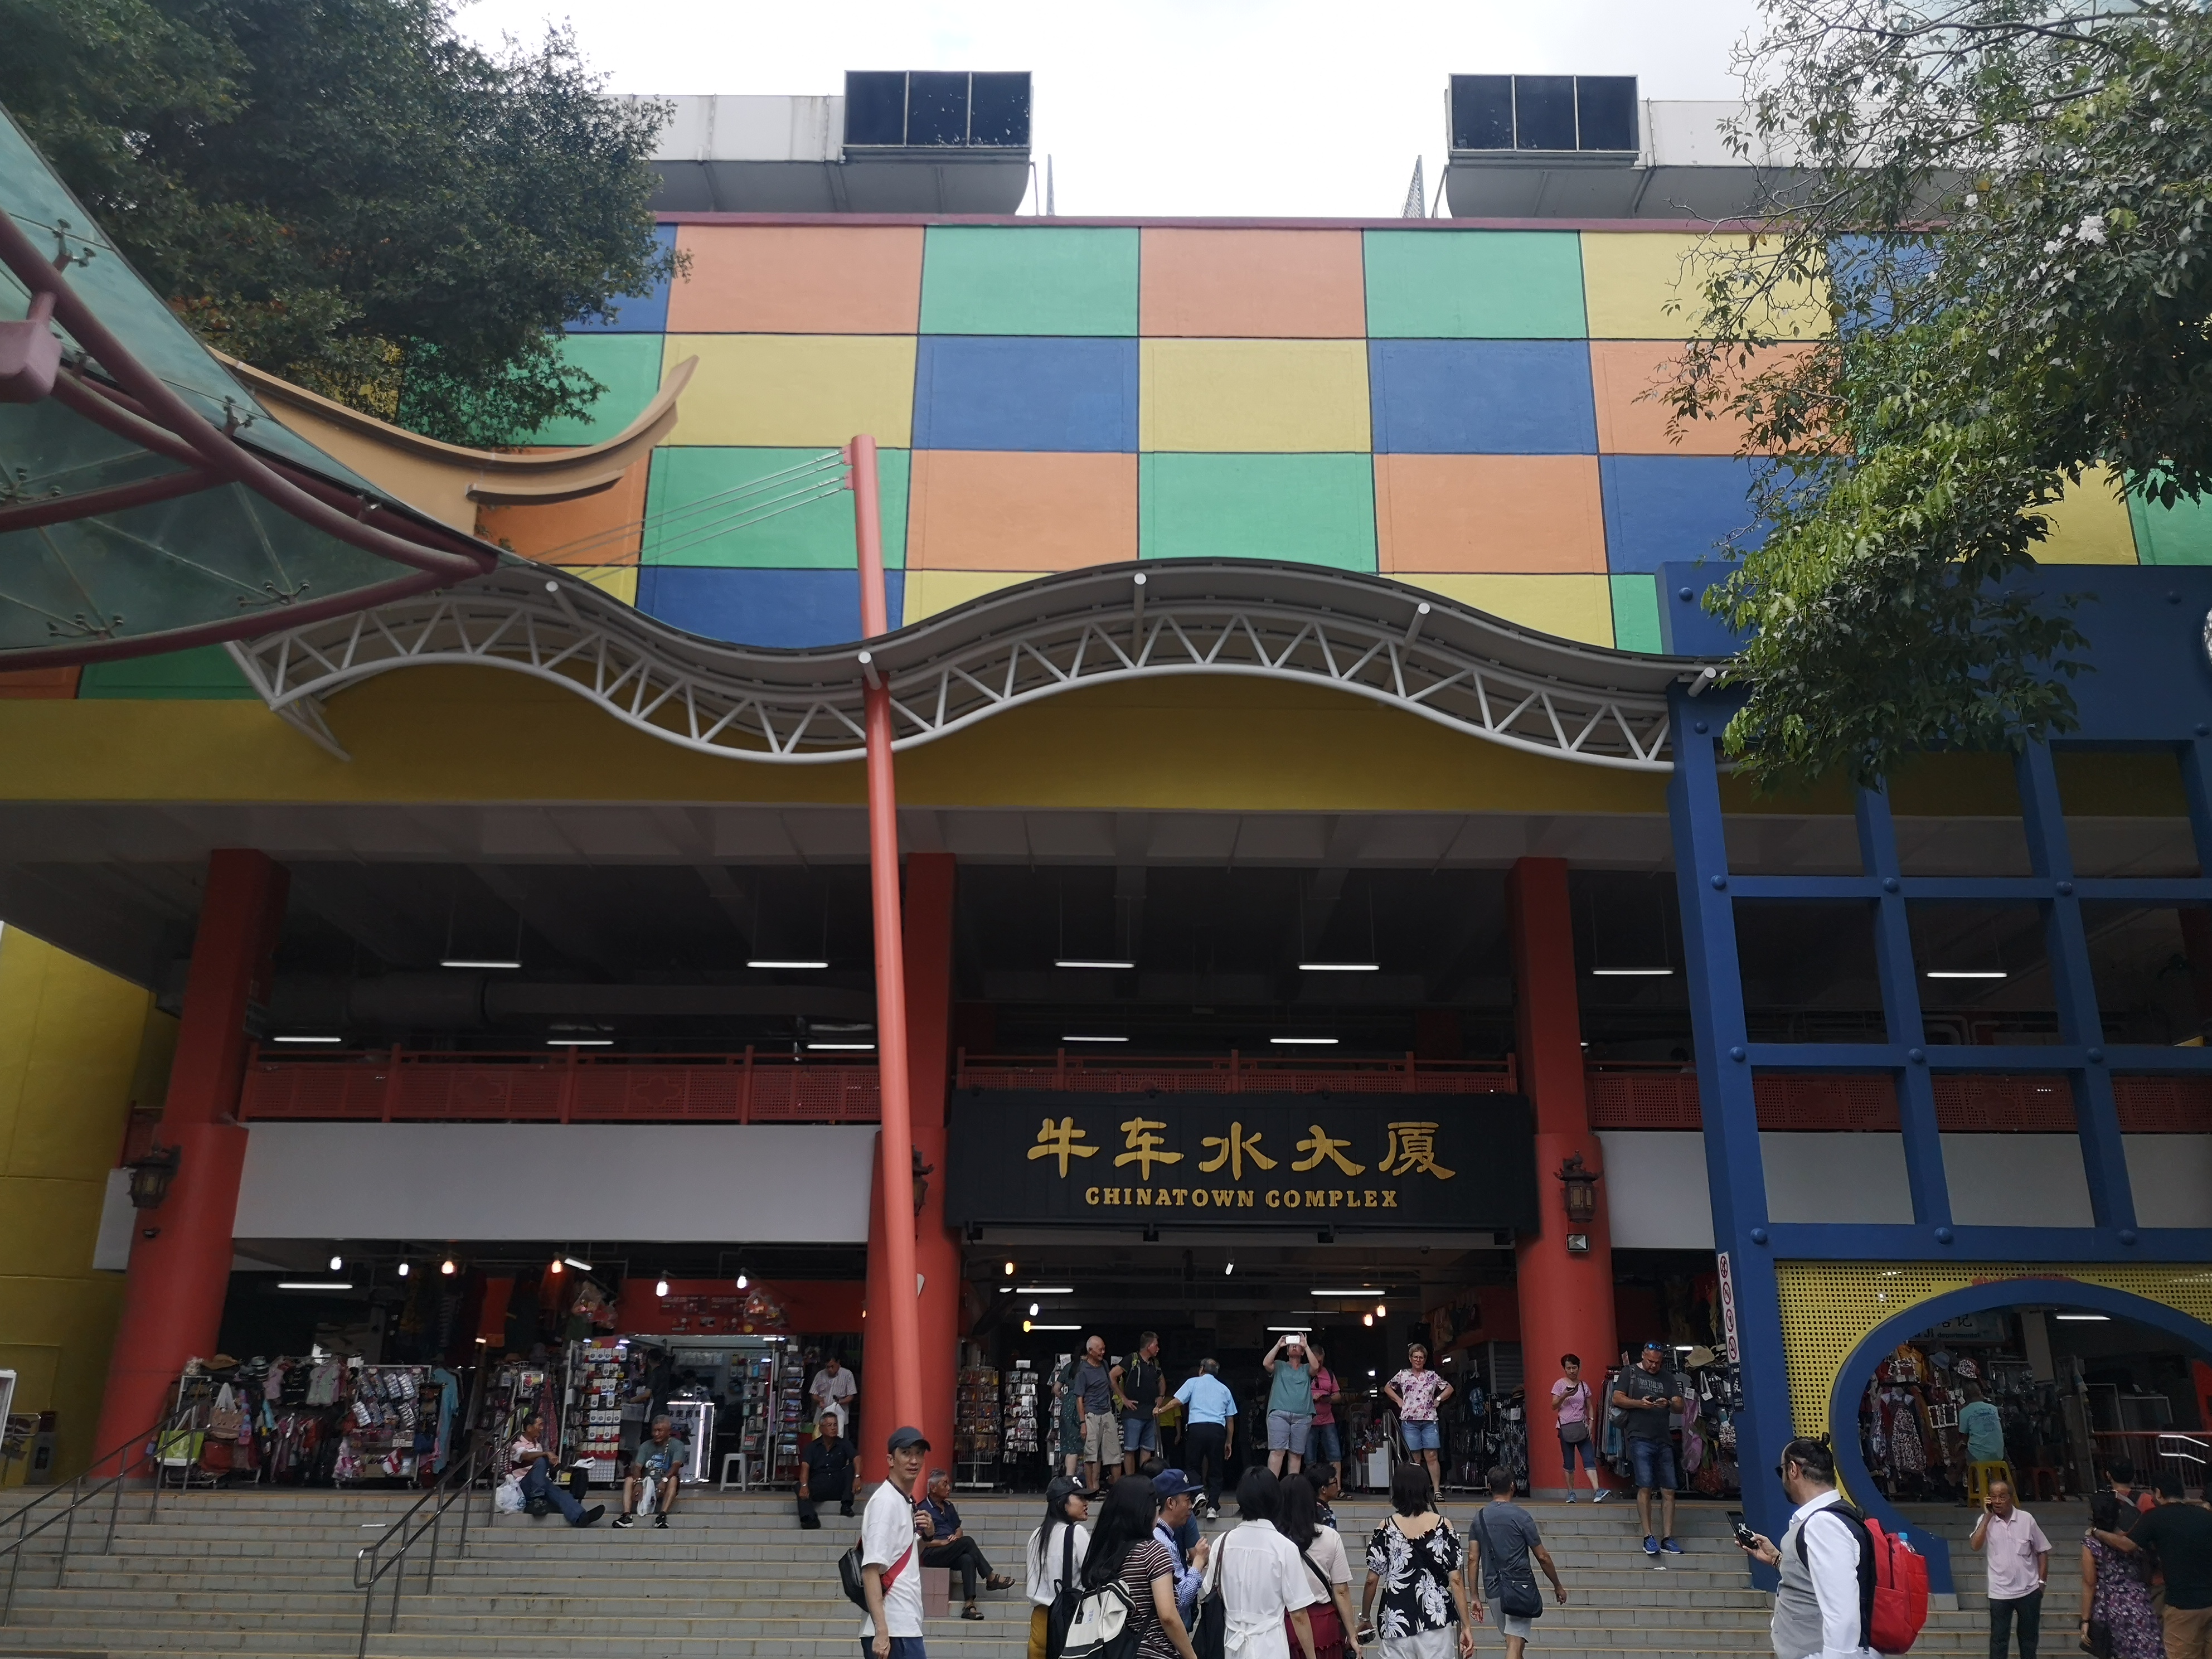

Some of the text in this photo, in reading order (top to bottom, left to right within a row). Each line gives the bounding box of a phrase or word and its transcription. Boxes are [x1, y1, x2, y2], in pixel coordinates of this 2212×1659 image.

[1027, 1117, 1455, 1181] 牛车水大厦
[1085, 1187, 1398, 1209] CHINATOWN COMPLEX
